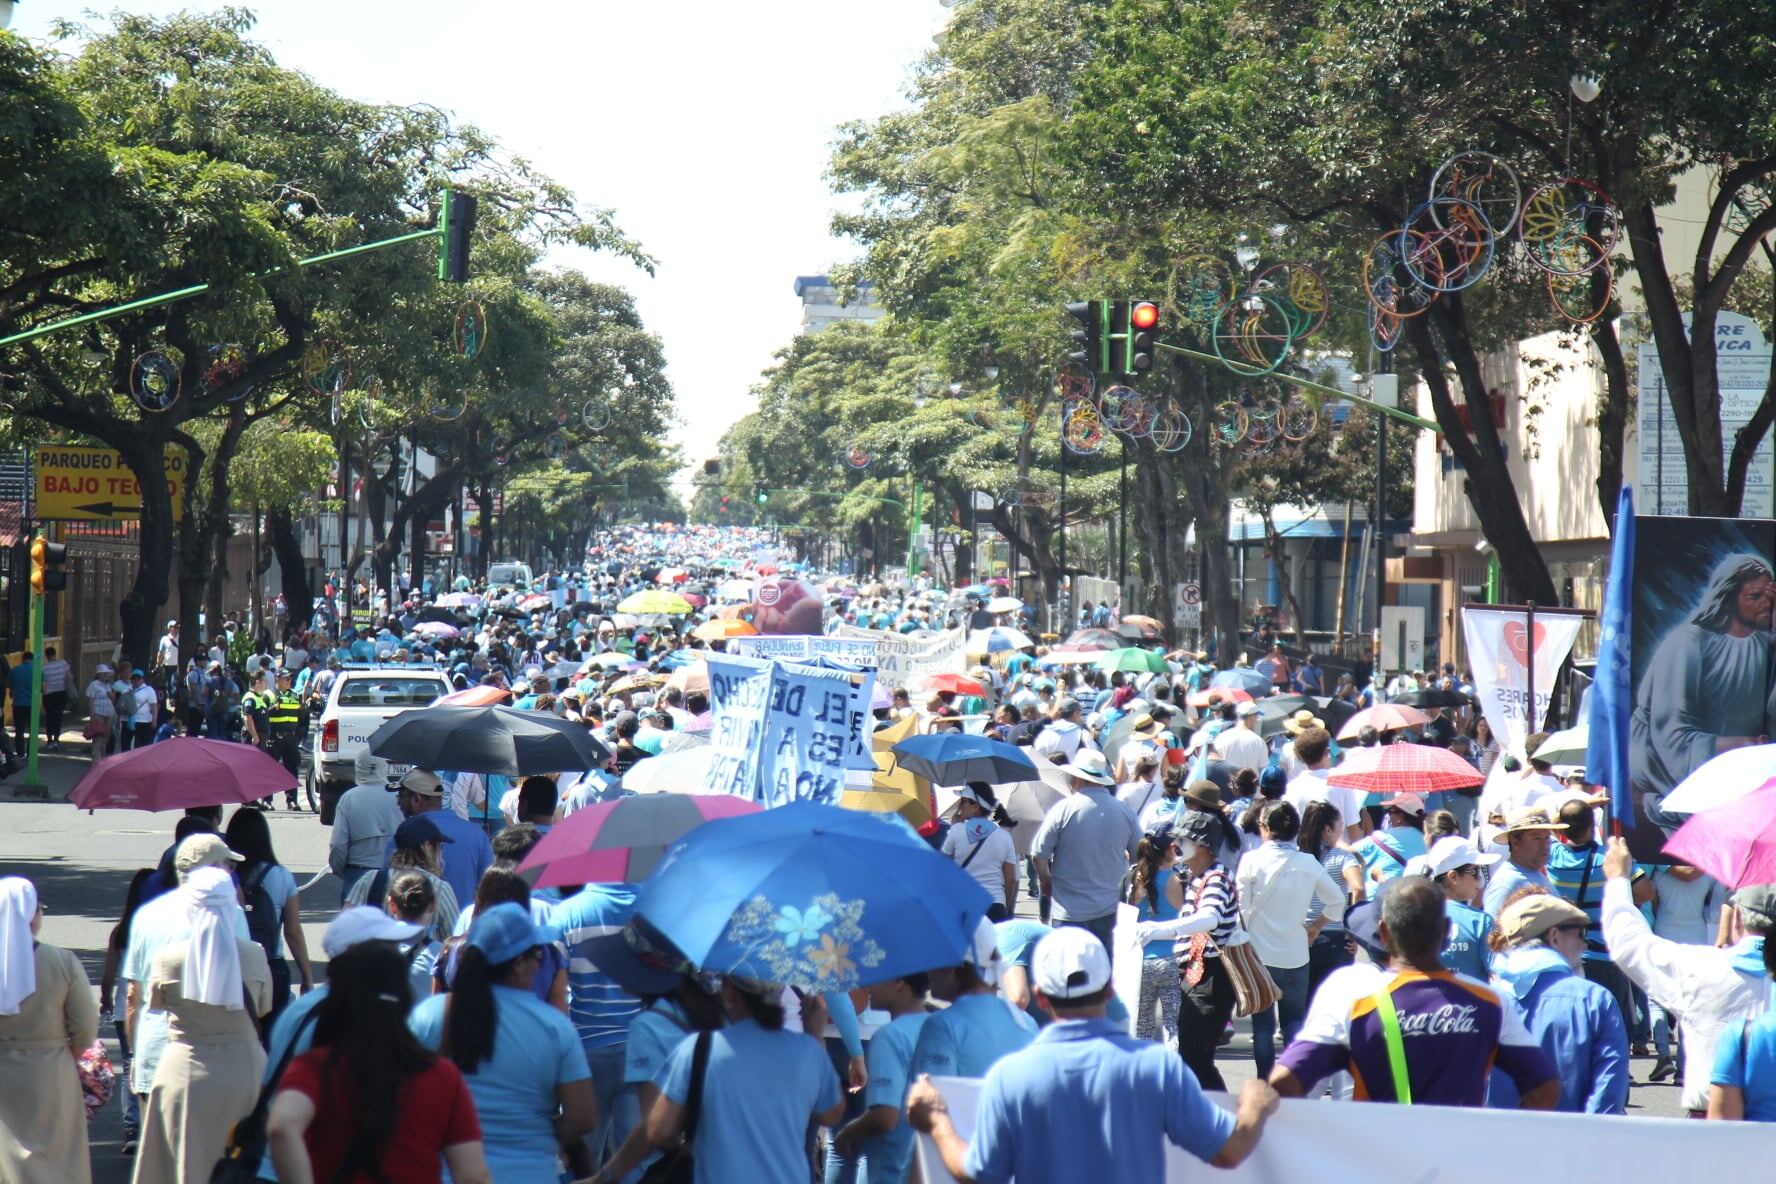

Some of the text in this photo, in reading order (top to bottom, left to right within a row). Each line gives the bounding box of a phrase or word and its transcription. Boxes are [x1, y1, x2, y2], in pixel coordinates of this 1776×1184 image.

[41, 452, 112, 470] PARQUEO
[44, 476, 177, 496] BAJO TECO
[347, 735, 368, 743] POL
